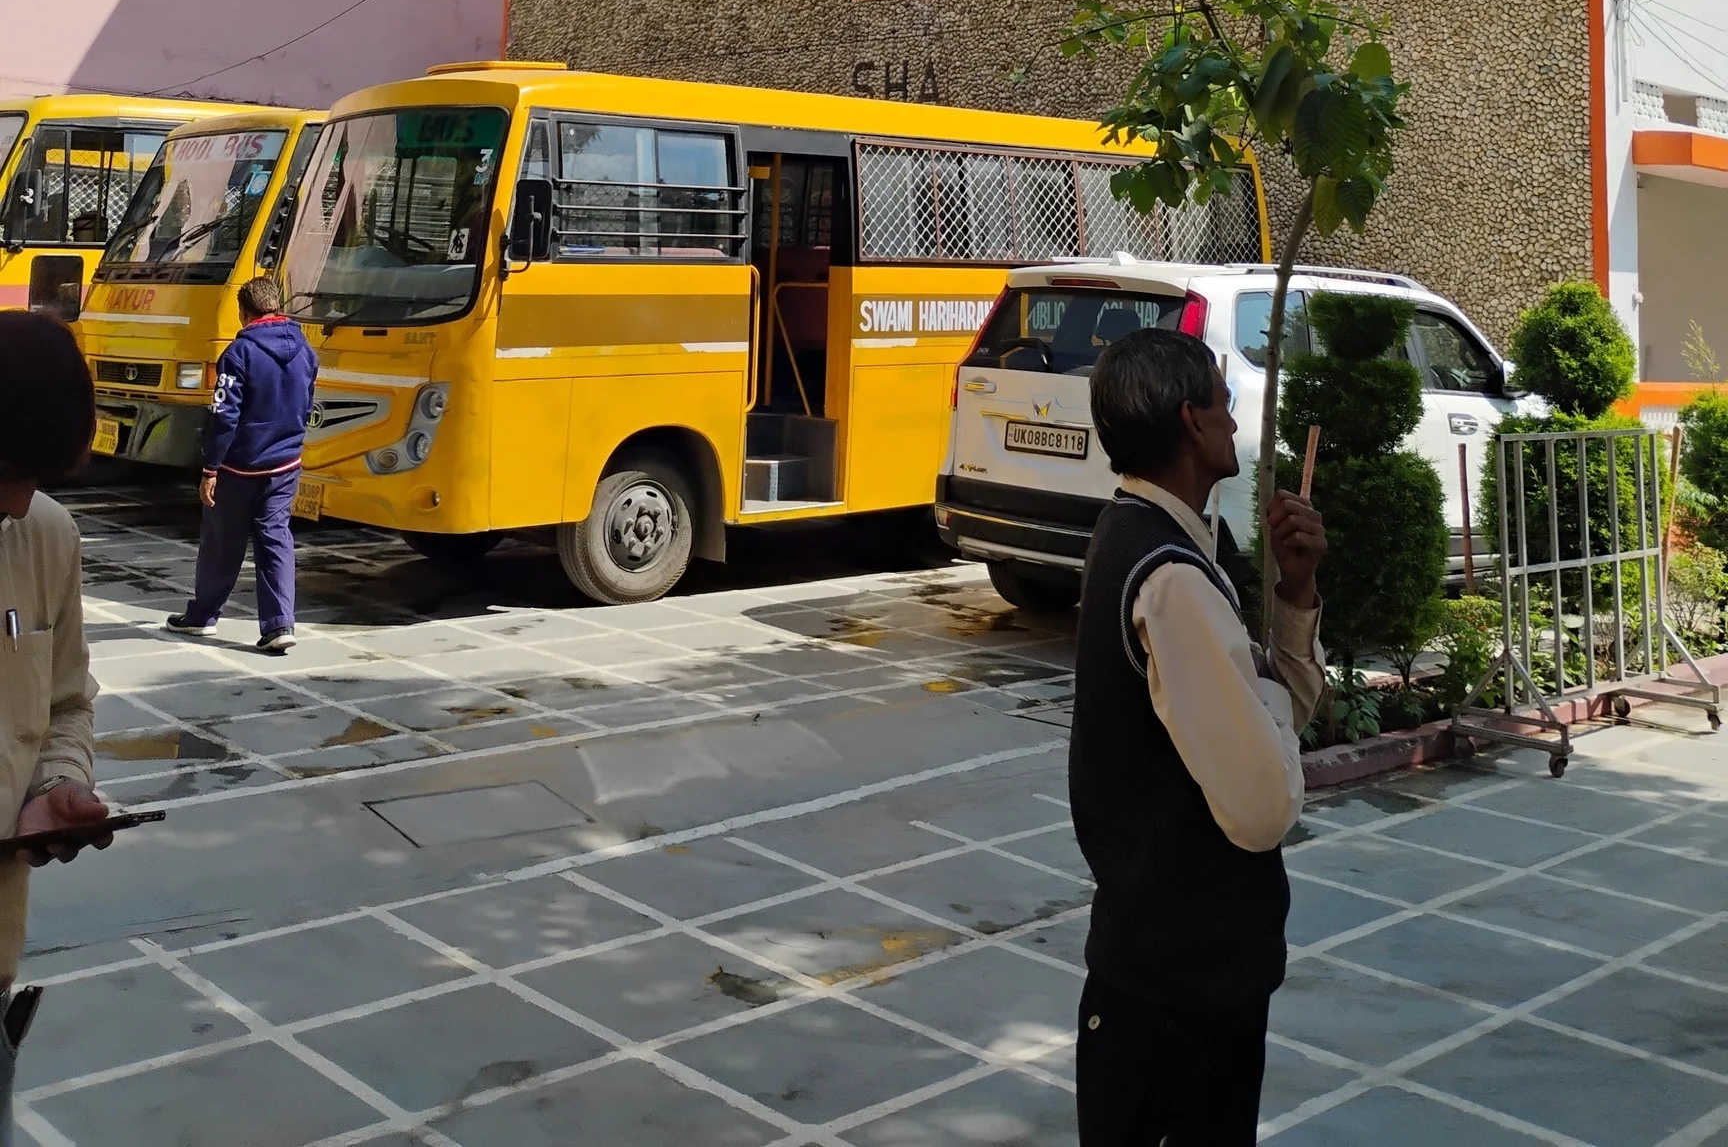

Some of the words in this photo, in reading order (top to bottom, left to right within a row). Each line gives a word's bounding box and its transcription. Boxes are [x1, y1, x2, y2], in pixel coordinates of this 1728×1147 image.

[475, 149, 494, 173] 3
[859, 300, 913, 332] SWAMI
[1013, 427, 1084, 452] UK08BC8118
